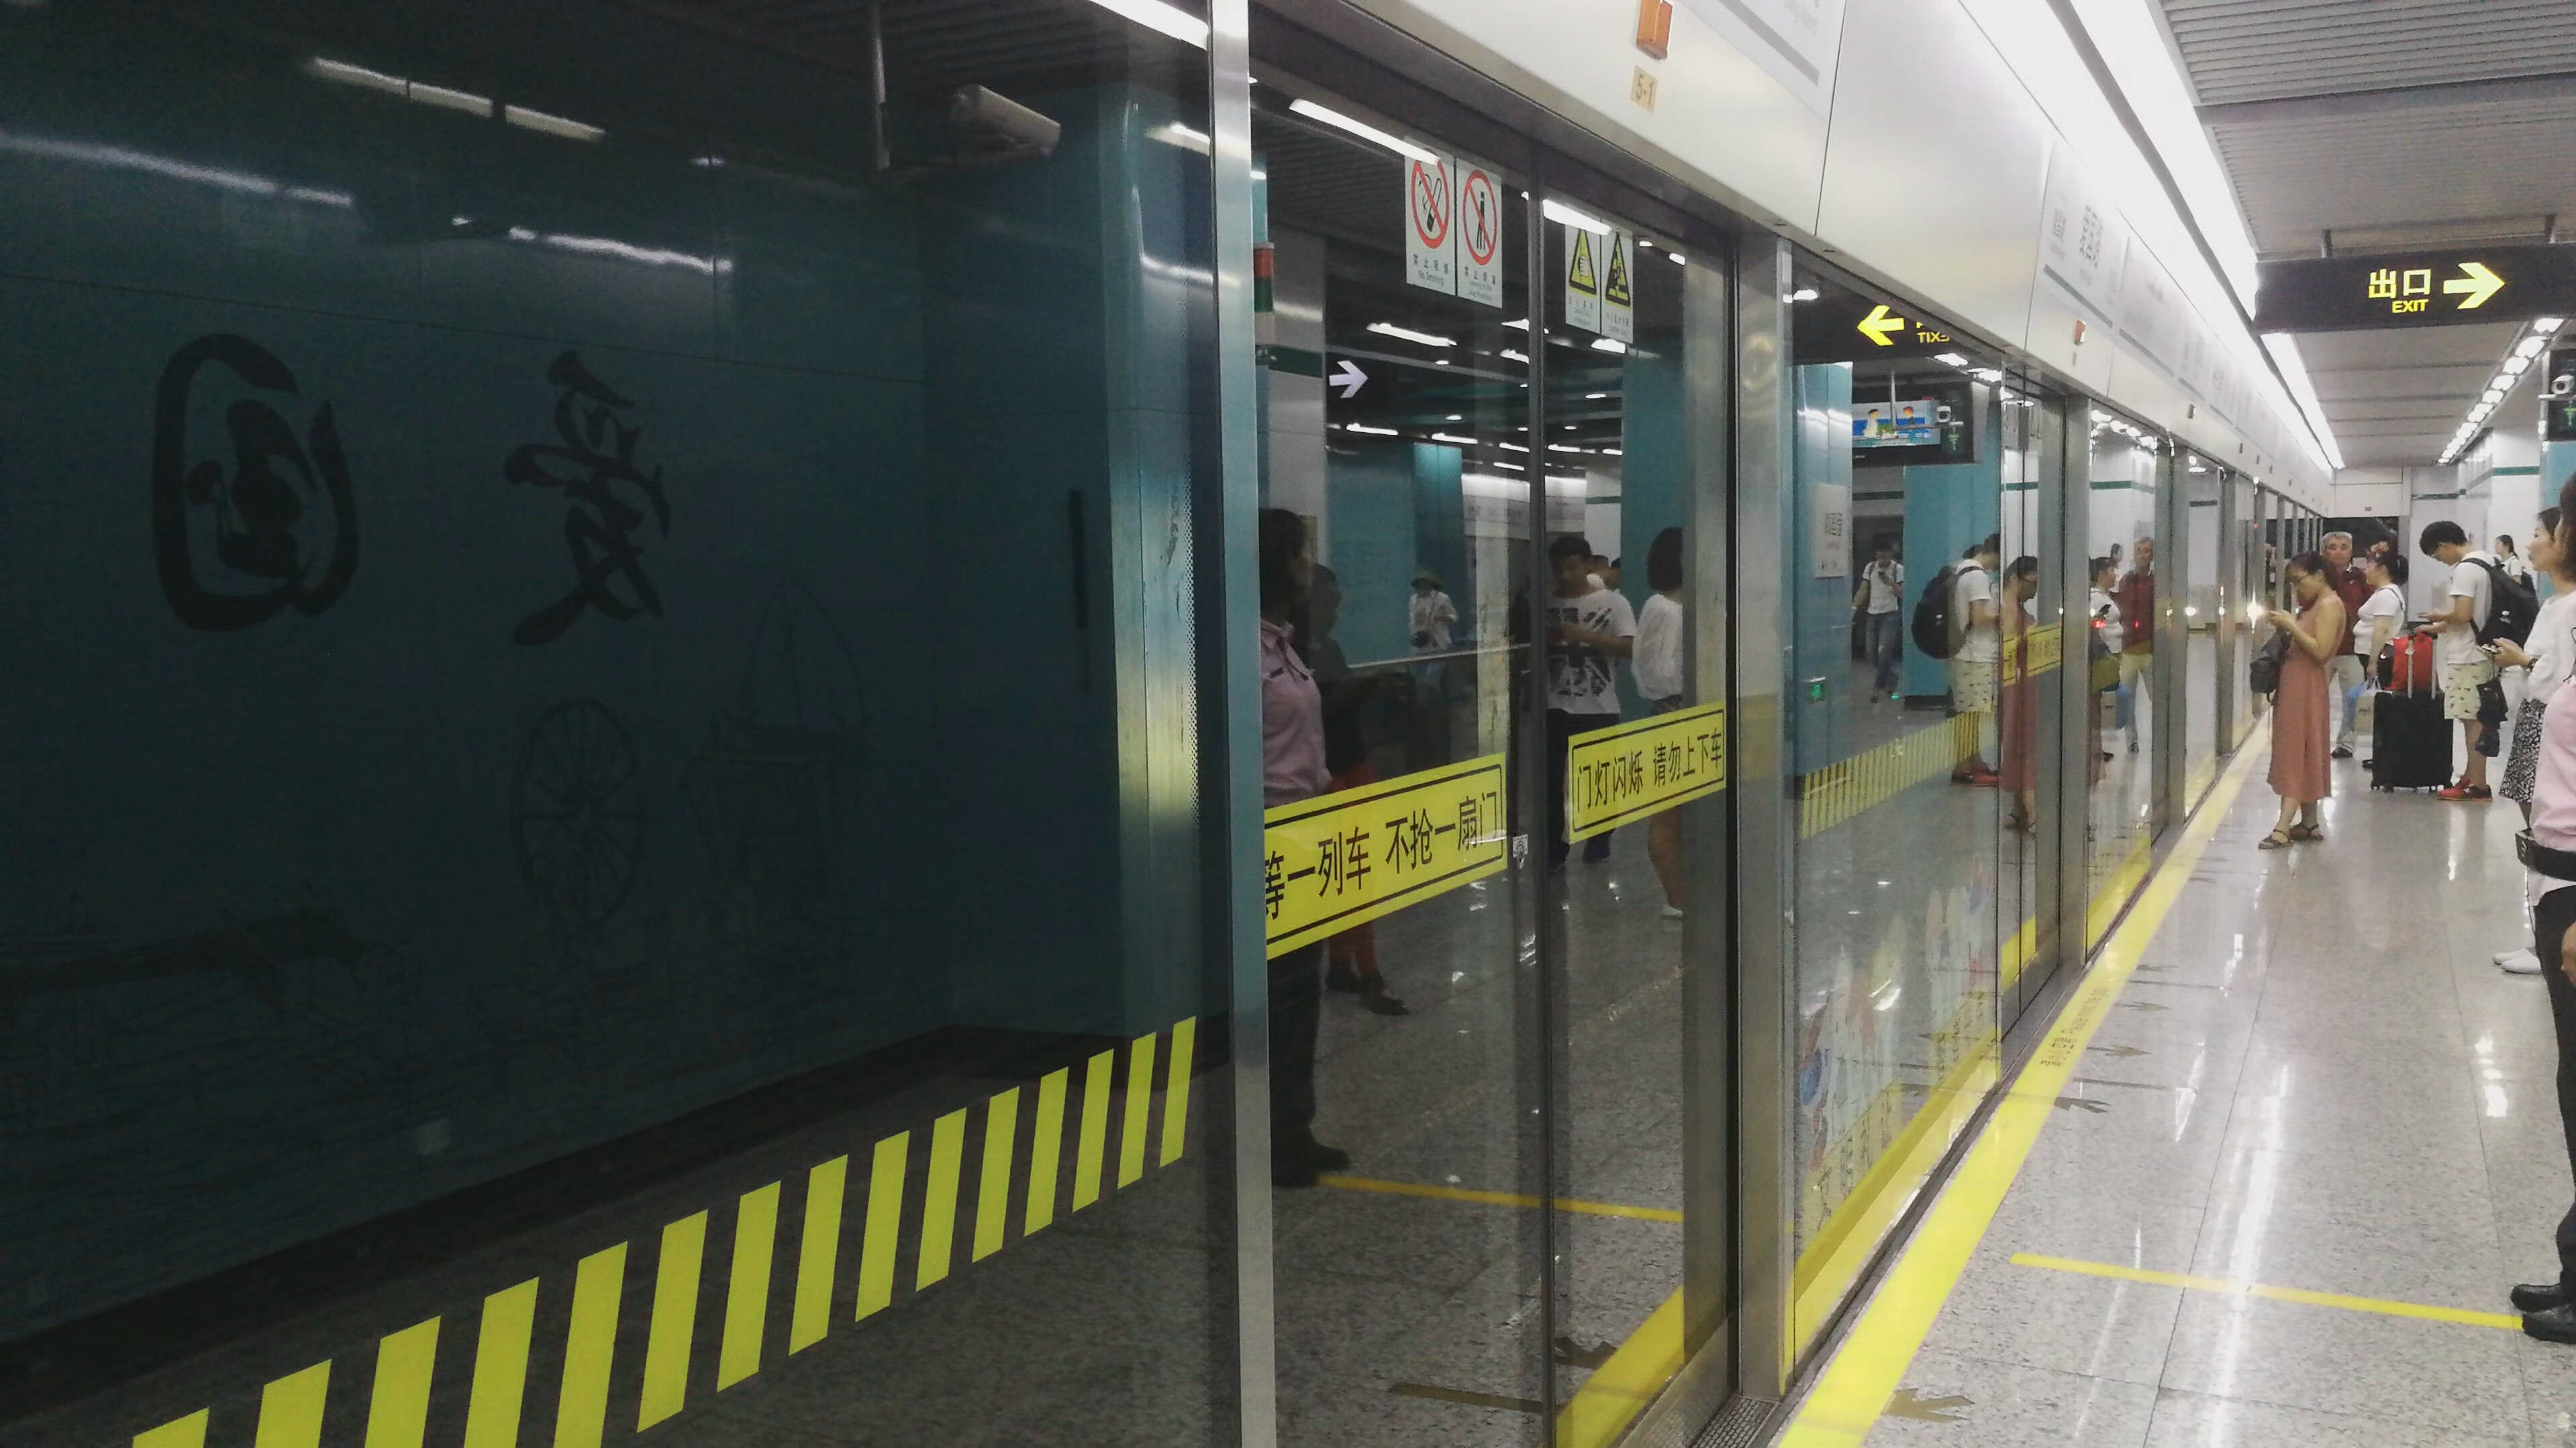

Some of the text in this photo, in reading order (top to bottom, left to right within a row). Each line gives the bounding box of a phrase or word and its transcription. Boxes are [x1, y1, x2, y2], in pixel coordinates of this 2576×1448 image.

[2368, 268, 2431, 299] 出口
[2391, 299, 2430, 314] EXIT
[1577, 727, 1722, 813] 门灯闪烁 请勿上下车
[1385, 790, 1497, 874] 不抢一扇门
